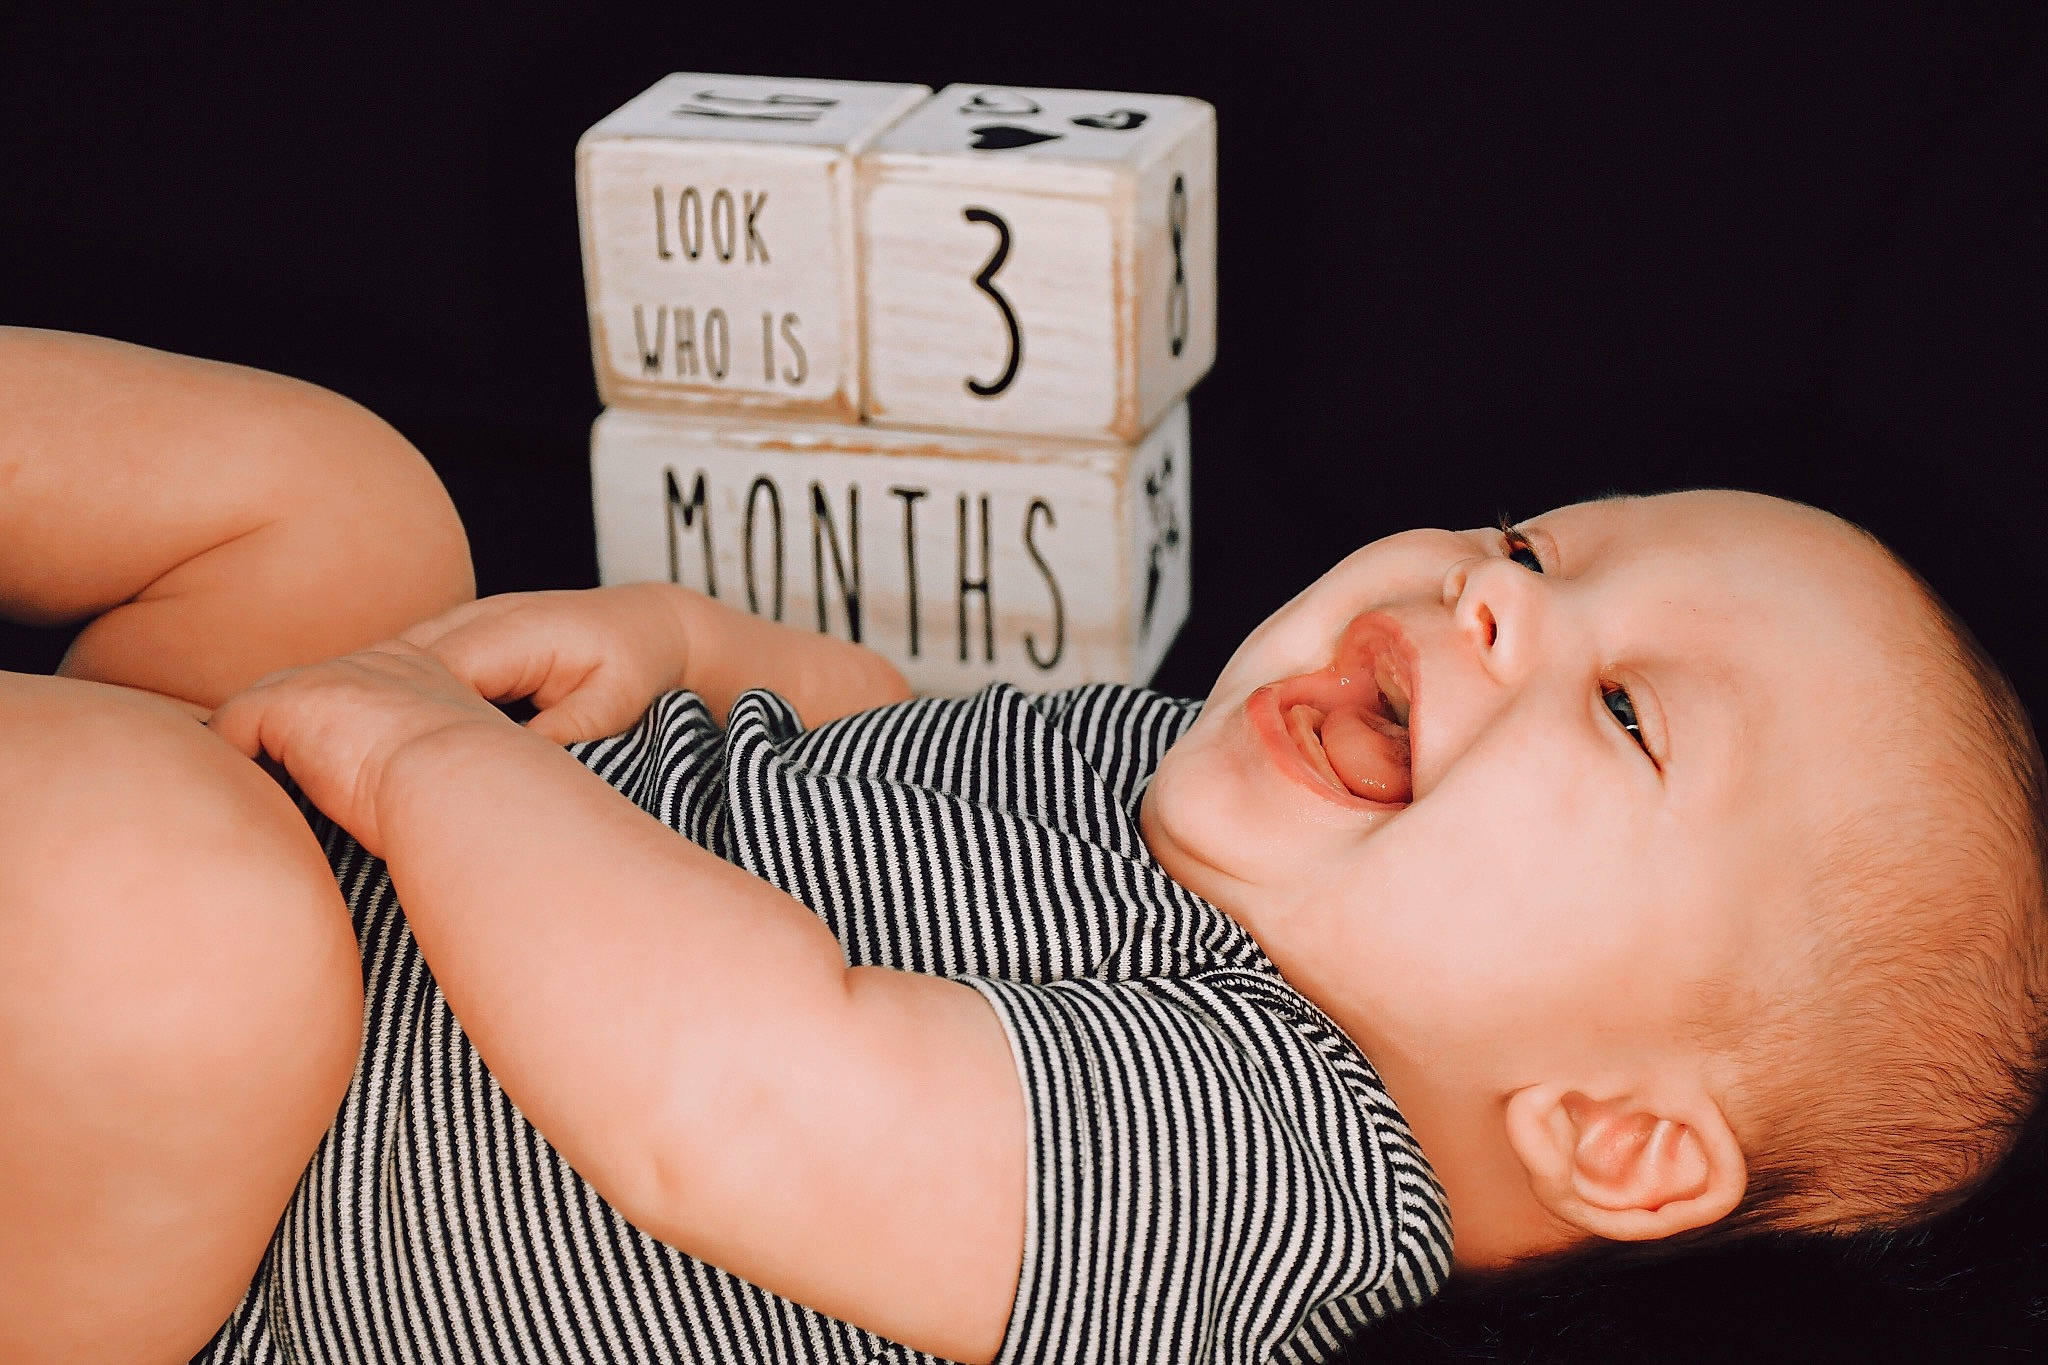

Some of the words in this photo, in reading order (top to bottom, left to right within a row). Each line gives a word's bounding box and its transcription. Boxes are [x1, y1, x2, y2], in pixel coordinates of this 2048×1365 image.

[652, 185, 770, 264] LOOK
[633, 303, 730, 381] WHO
[762, 310, 809, 387] IS
[964, 207, 1021, 397] 3
[664, 467, 1066, 669] MONTHS
